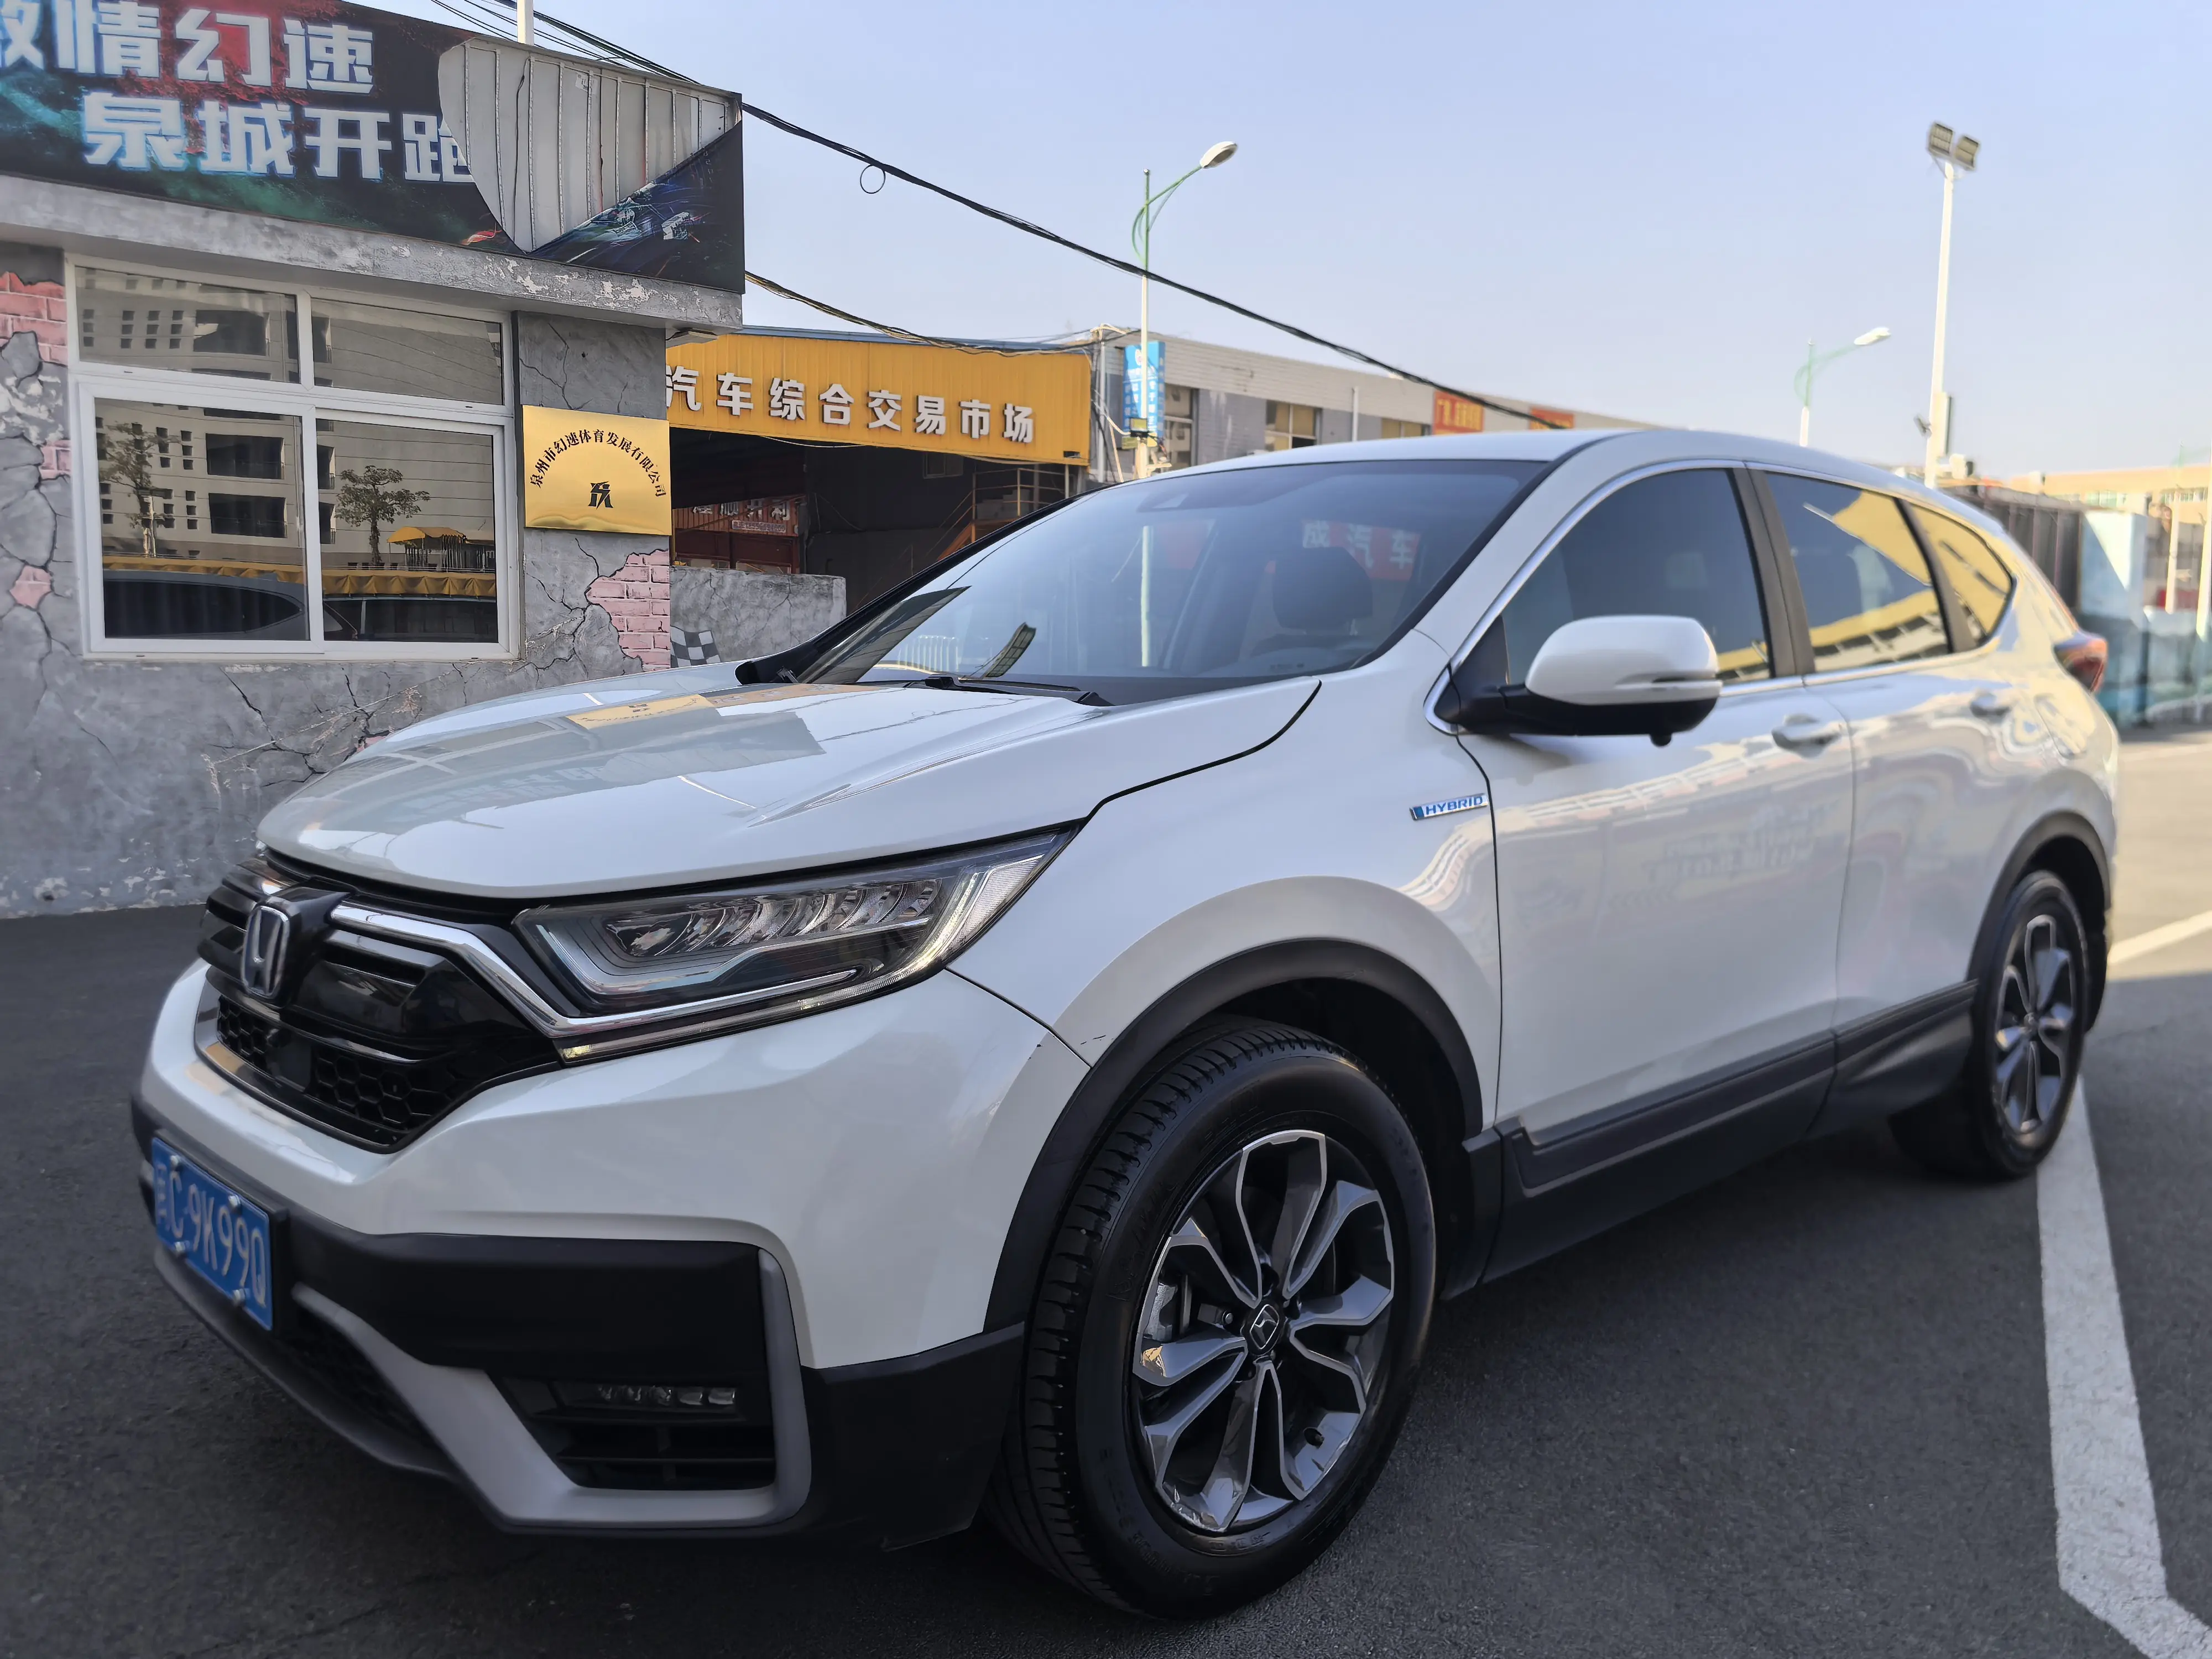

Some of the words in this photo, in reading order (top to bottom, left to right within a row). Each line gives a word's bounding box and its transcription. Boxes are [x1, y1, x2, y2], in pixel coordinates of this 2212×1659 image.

[666, 366, 1033, 443] 汽车综合交易市场
[530, 429, 666, 497] 泉州市幻速体育发展有限公司
[1426, 796, 1483, 815] HYBRID
